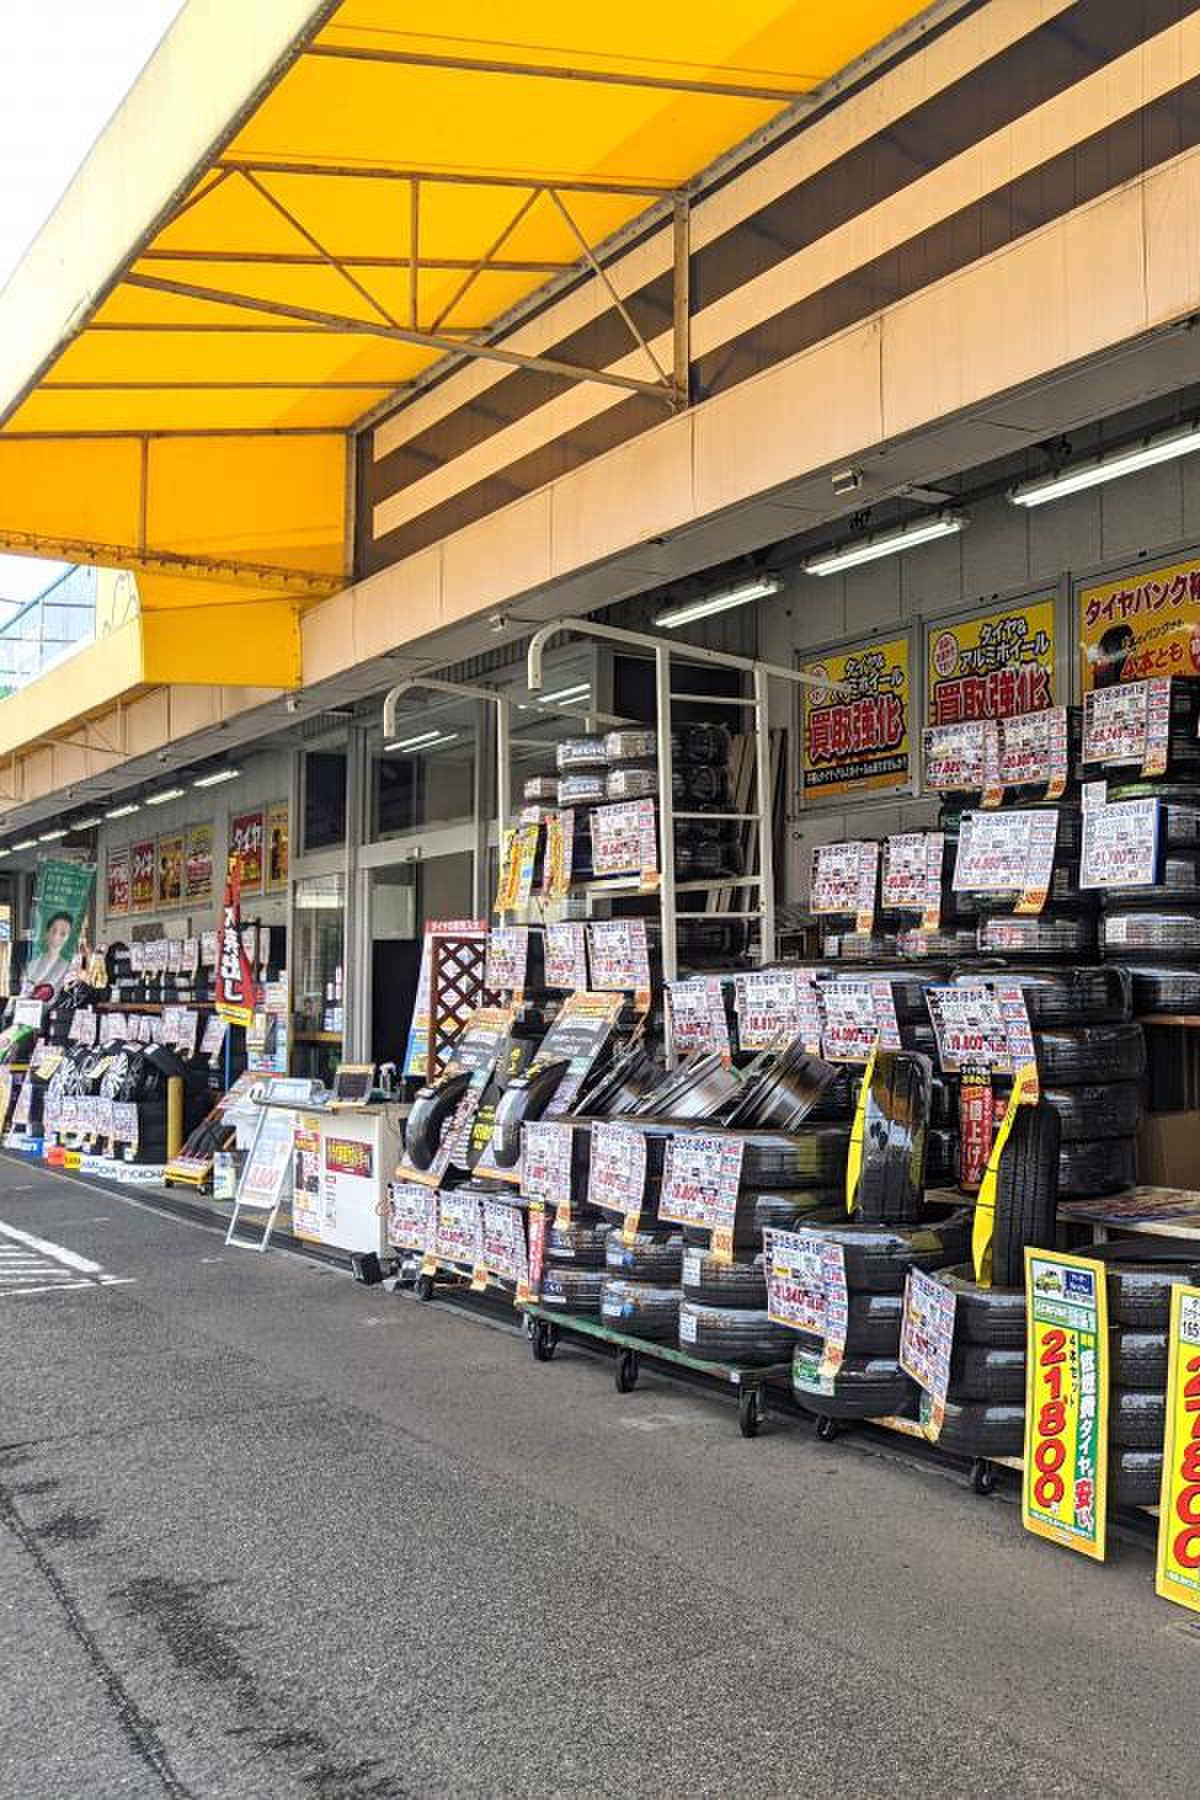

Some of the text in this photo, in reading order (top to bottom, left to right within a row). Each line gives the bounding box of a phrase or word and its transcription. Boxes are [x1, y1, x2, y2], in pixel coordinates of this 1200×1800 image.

[960, 631, 1050, 673] アルミホイール
[1120, 642, 1184, 680] 4本とも
[937, 662, 1051, 723] 買取強化
[810, 692, 904, 763] 買取強化
